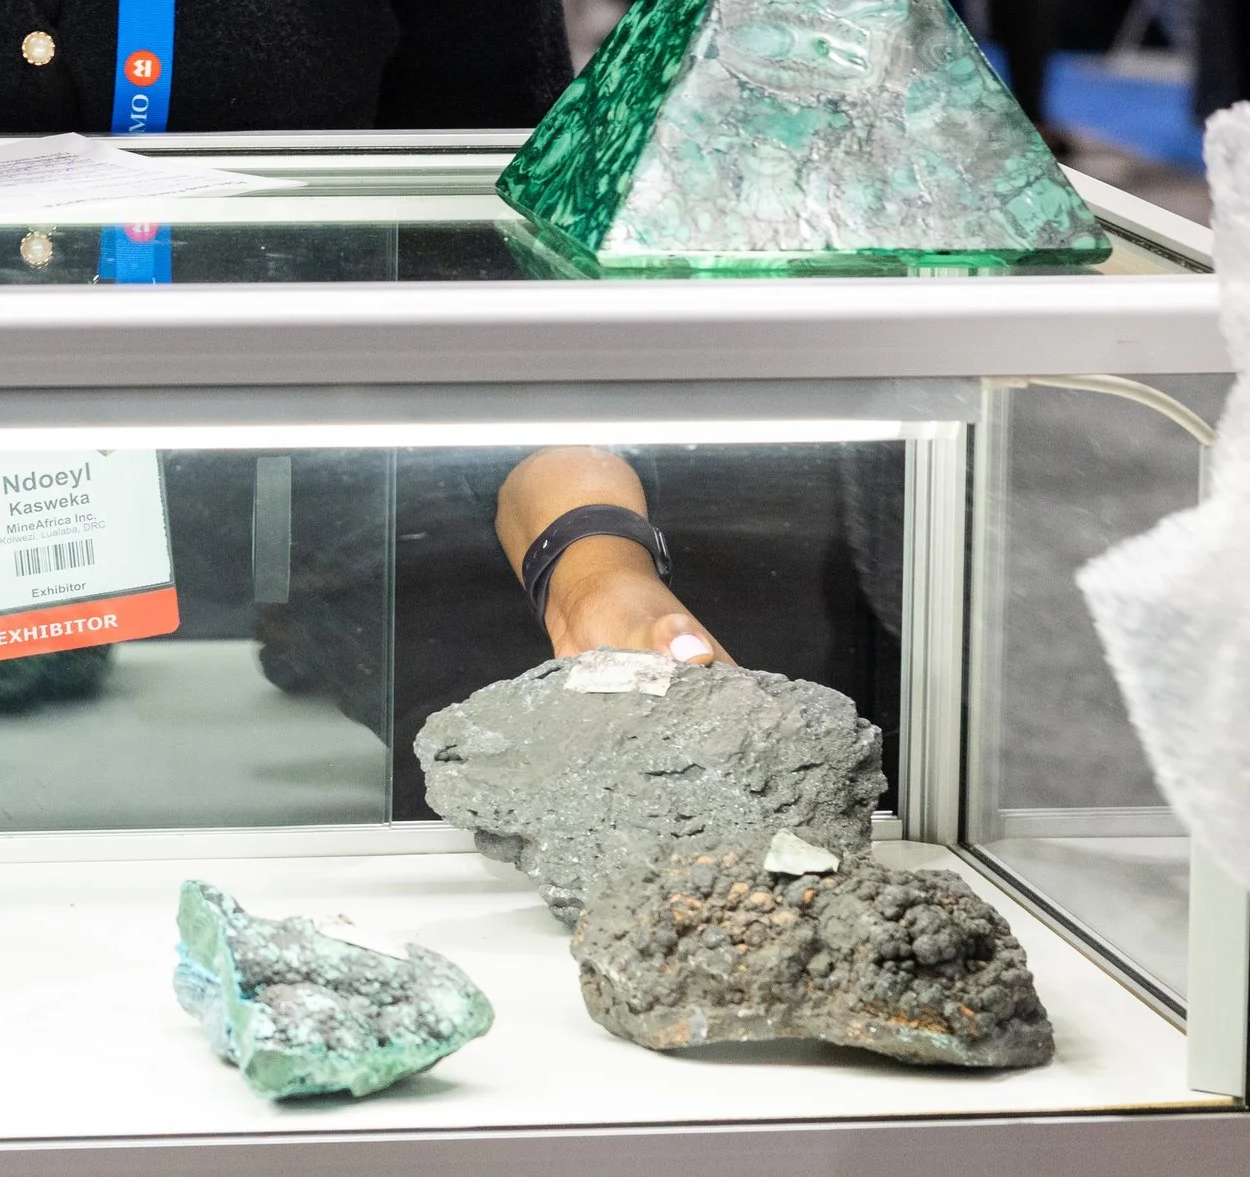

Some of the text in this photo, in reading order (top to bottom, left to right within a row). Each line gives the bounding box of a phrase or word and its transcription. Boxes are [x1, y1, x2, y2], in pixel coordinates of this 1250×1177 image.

[129, 93, 149, 132] MO
[2, 462, 92, 495] Ndoeyl
[8, 492, 91, 517] Kasweka
[6, 513, 98, 534] MineAfrica Inc.
[83, 520, 106, 533] DRC
[31, 581, 87, 599] Exhibitor
